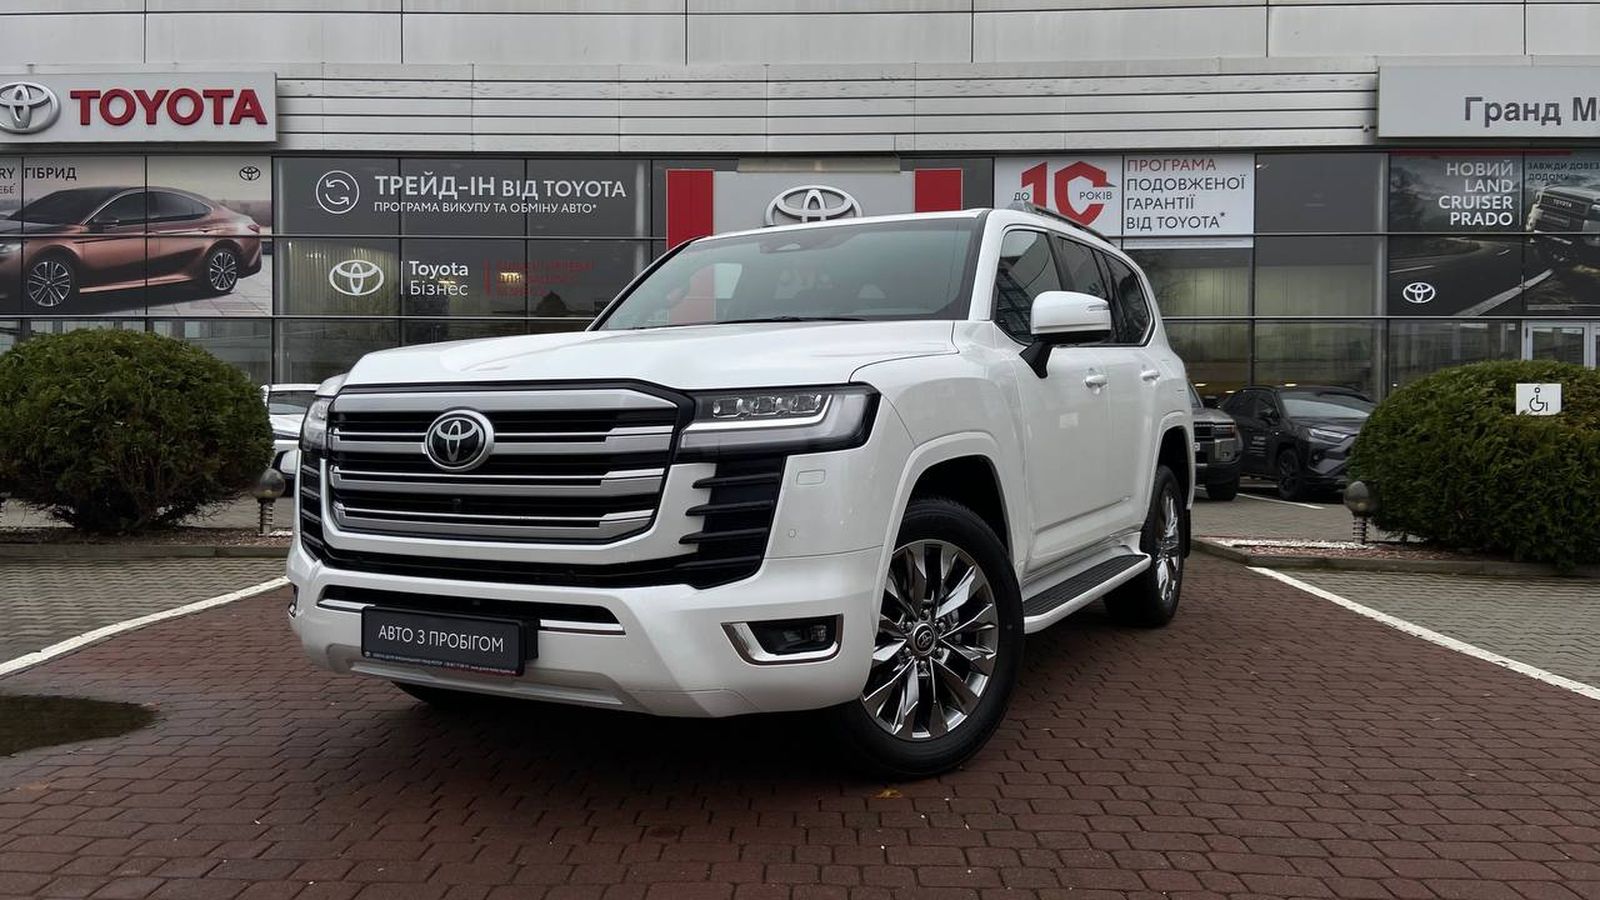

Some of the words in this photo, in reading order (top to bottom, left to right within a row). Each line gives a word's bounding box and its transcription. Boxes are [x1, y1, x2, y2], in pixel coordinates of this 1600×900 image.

[70, 88, 268, 126] TOYOTA
[1464, 96, 1562, 128] Гранд
[1572, 96, 1600, 122] М
[1127, 158, 1216, 172] ПРОГРАМА
[1446, 160, 1514, 177] НОВИЙ
[24, 167, 77, 181] ГІБРИД
[374, 171, 496, 200] ТРЕЙД-ІН
[502, 180, 539, 200] ВІД
[543, 180, 627, 198] TOYOTA
[1127, 174, 1247, 193] ПОДОВЖЕНОЇ
[1464, 179, 1514, 193] LAND
[1013, 192, 1030, 201] ДО
[1080, 191, 1112, 200] РОКІВ
[1126, 194, 1195, 211] ГАРАНТІЇ
[1438, 195, 1514, 210] CRUISER
[374, 202, 440, 213] ПРОГРАМА
[442, 202, 491, 213] ВИКУПУ
[495, 203, 507, 213] ТА
[510, 203, 558, 214] ОБМІНУ
[1126, 216, 1152, 232] ВІД
[1450, 212, 1514, 226] PRADO
[409, 260, 469, 280] Toyota
[410, 280, 469, 296] Бізнес
[378, 624, 414, 643] АВТО
[417, 629, 426, 645] З
[429, 631, 504, 653] ПРОБІГОМ
